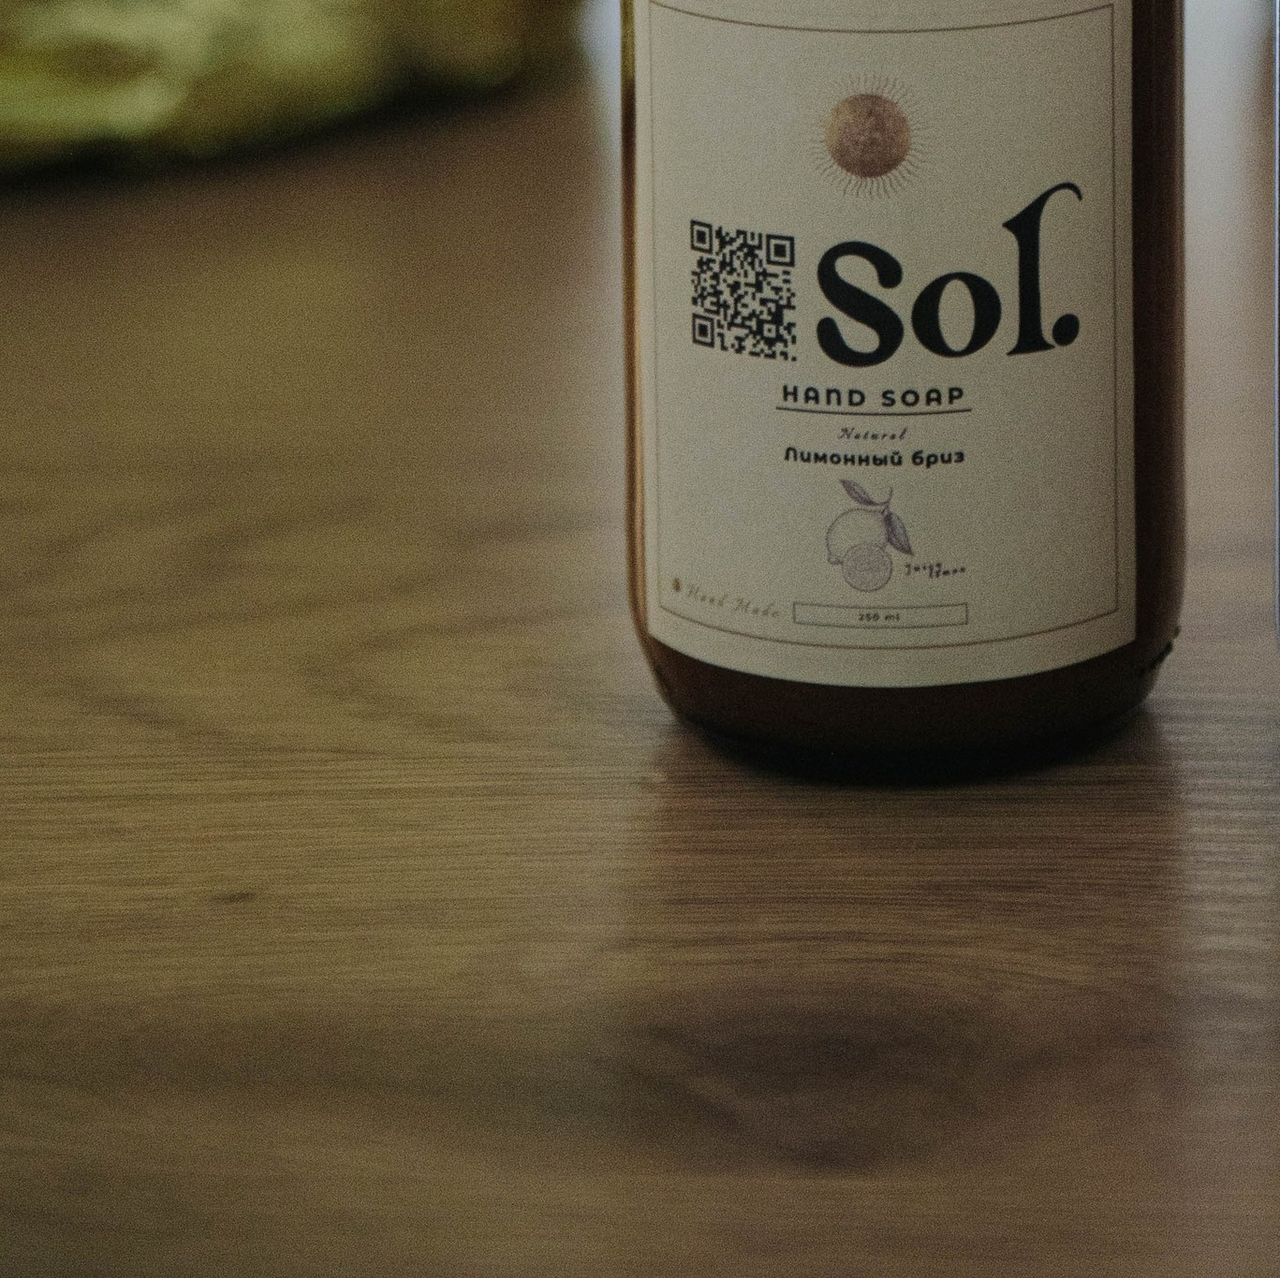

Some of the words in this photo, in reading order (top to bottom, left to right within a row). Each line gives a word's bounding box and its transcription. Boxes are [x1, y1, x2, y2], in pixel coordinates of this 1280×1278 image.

[816, 182, 1084, 368] Sol.
[782, 384, 867, 407] HAND
[881, 386, 966, 407] SOAP
[837, 426, 908, 441] Natural
[784, 446, 904, 467] Лимонный
[911, 449, 966, 469] бриз
